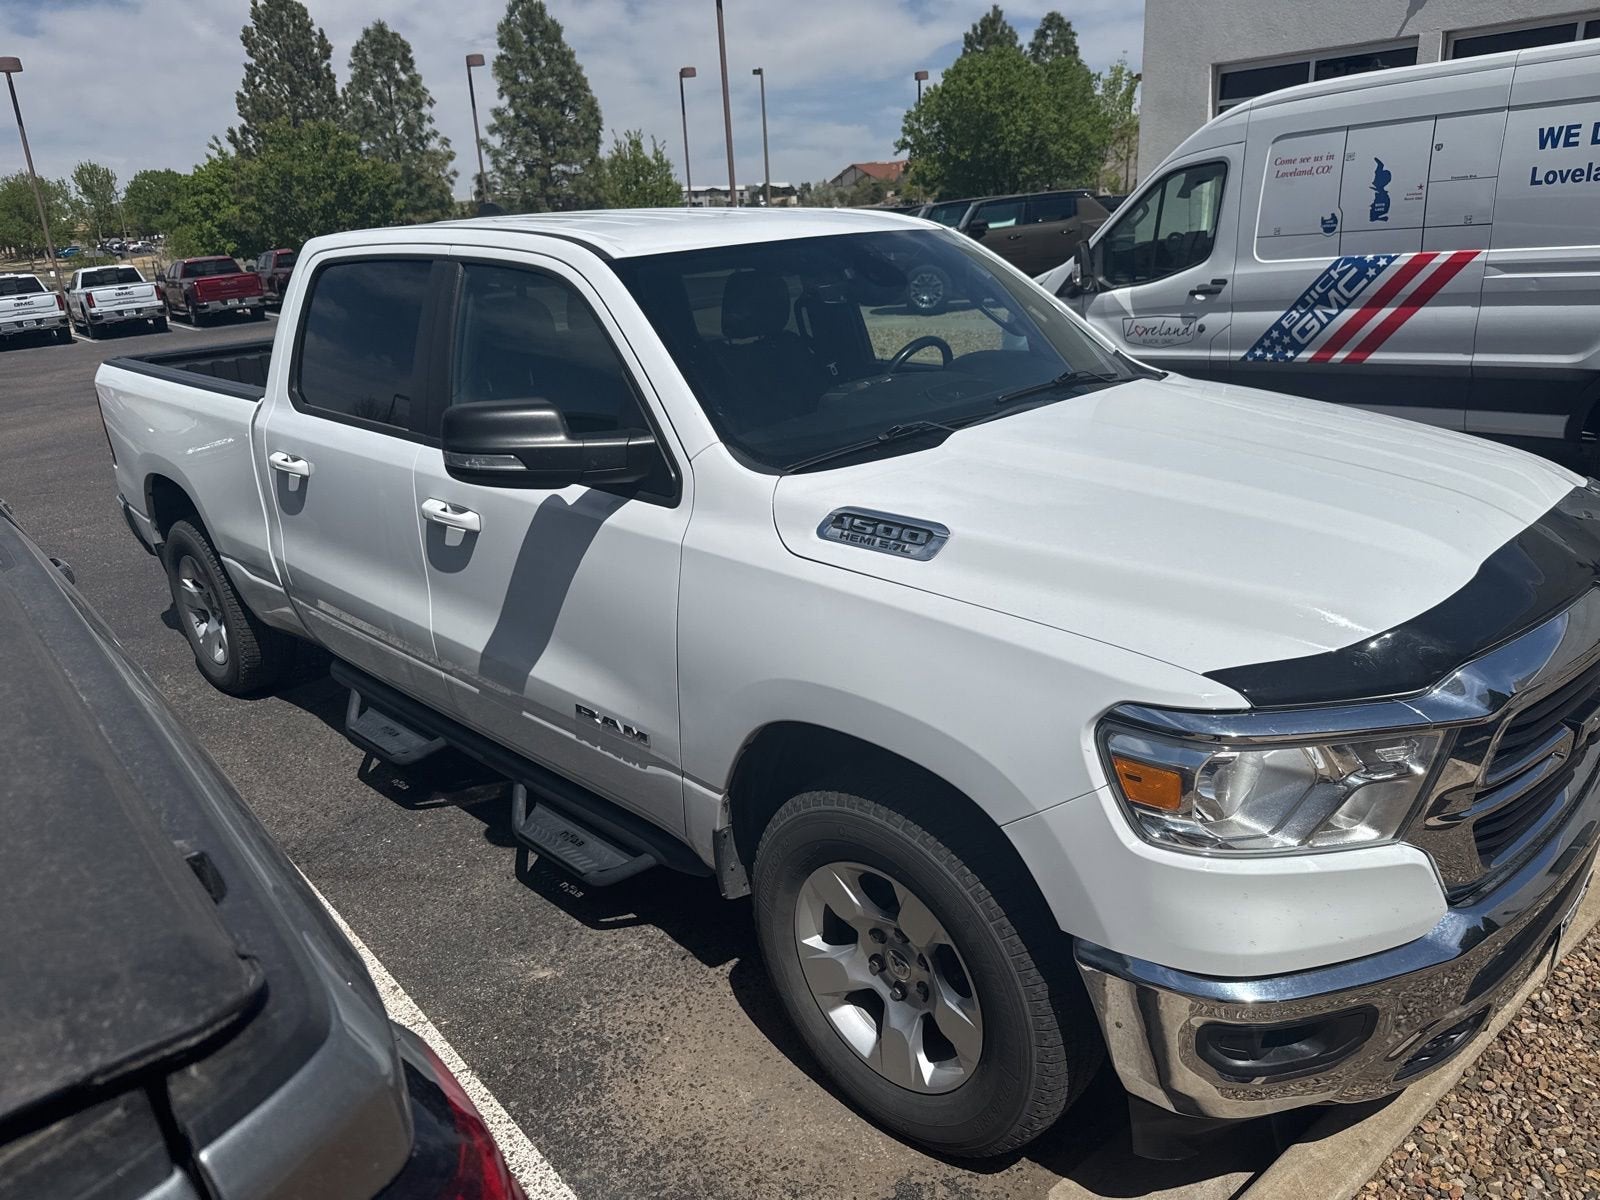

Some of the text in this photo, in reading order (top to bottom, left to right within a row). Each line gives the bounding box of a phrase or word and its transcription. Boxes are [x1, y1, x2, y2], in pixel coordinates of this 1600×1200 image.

[1538, 124, 1582, 150] WE
[1275, 157, 1297, 166] Come
[1326, 152, 1334, 161] in
[1281, 257, 1352, 330] BUICK
[1291, 267, 1368, 345] GMC
[831, 513, 934, 546] 1500
[839, 530, 912, 554] HEMI 5.7L
[575, 704, 651, 748] RAM
